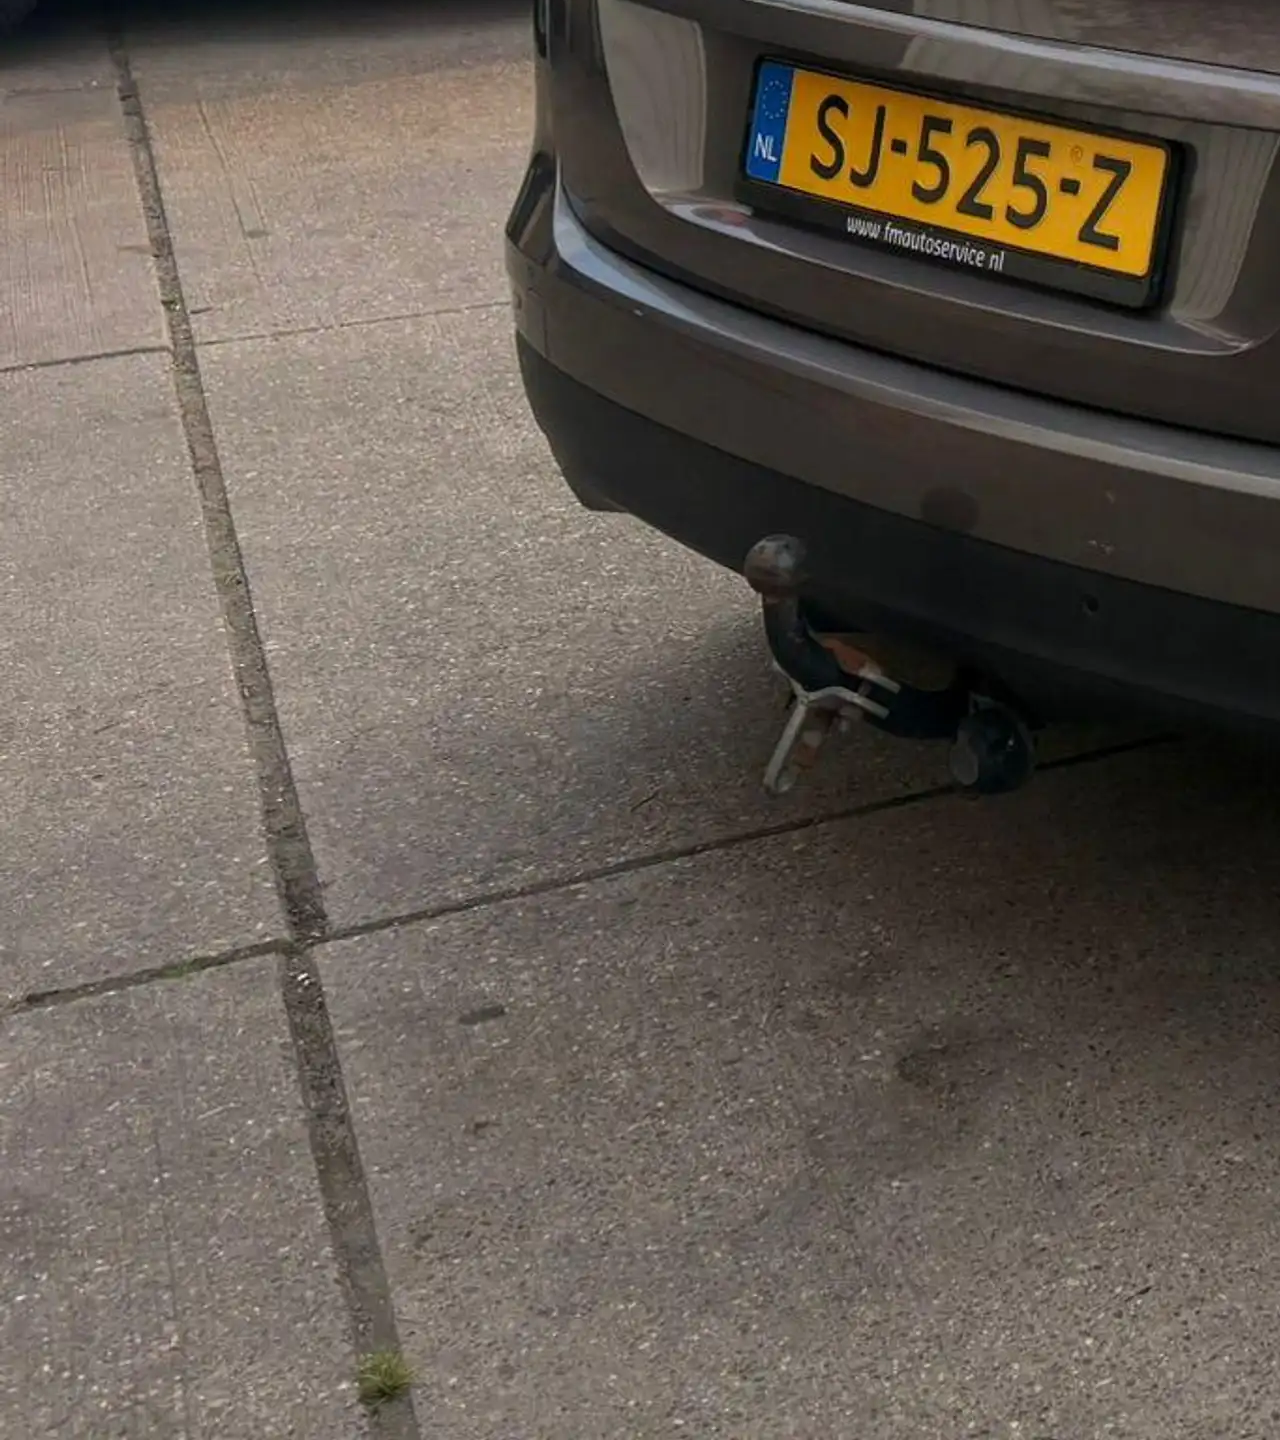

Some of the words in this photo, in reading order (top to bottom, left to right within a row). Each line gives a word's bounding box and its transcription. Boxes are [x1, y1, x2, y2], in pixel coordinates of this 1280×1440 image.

[754, 133, 777, 162] NL
[810, 94, 1132, 250] SJ-525-Z
[847, 216, 1005, 271] wwwfmautoservicenl
